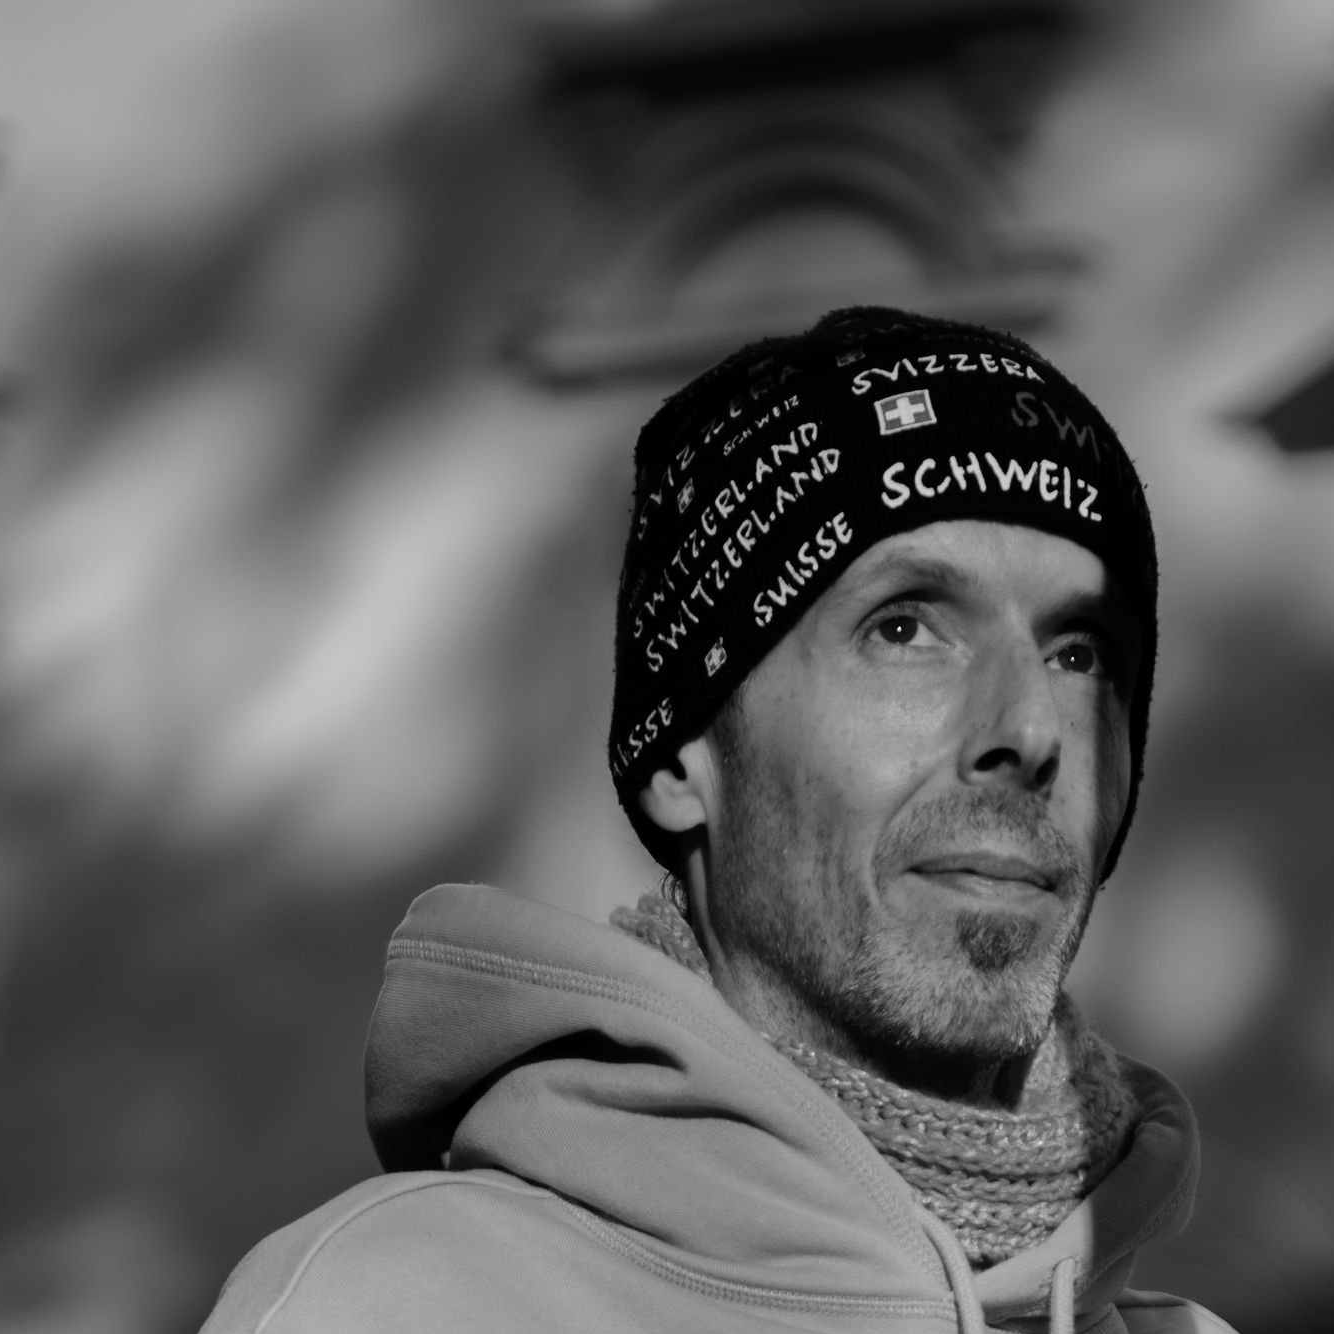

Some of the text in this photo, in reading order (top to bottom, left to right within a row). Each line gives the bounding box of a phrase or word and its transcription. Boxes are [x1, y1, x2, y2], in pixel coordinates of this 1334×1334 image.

[852, 353, 1046, 395] SVIZZERA
[723, 395, 799, 457] SCHWEIZ
[634, 422, 819, 638] SWITZERLAND
[881, 451, 1102, 521] SCHWEIZ
[646, 448, 840, 672] SWITZERLAND
[753, 512, 853, 627] SUISSE
